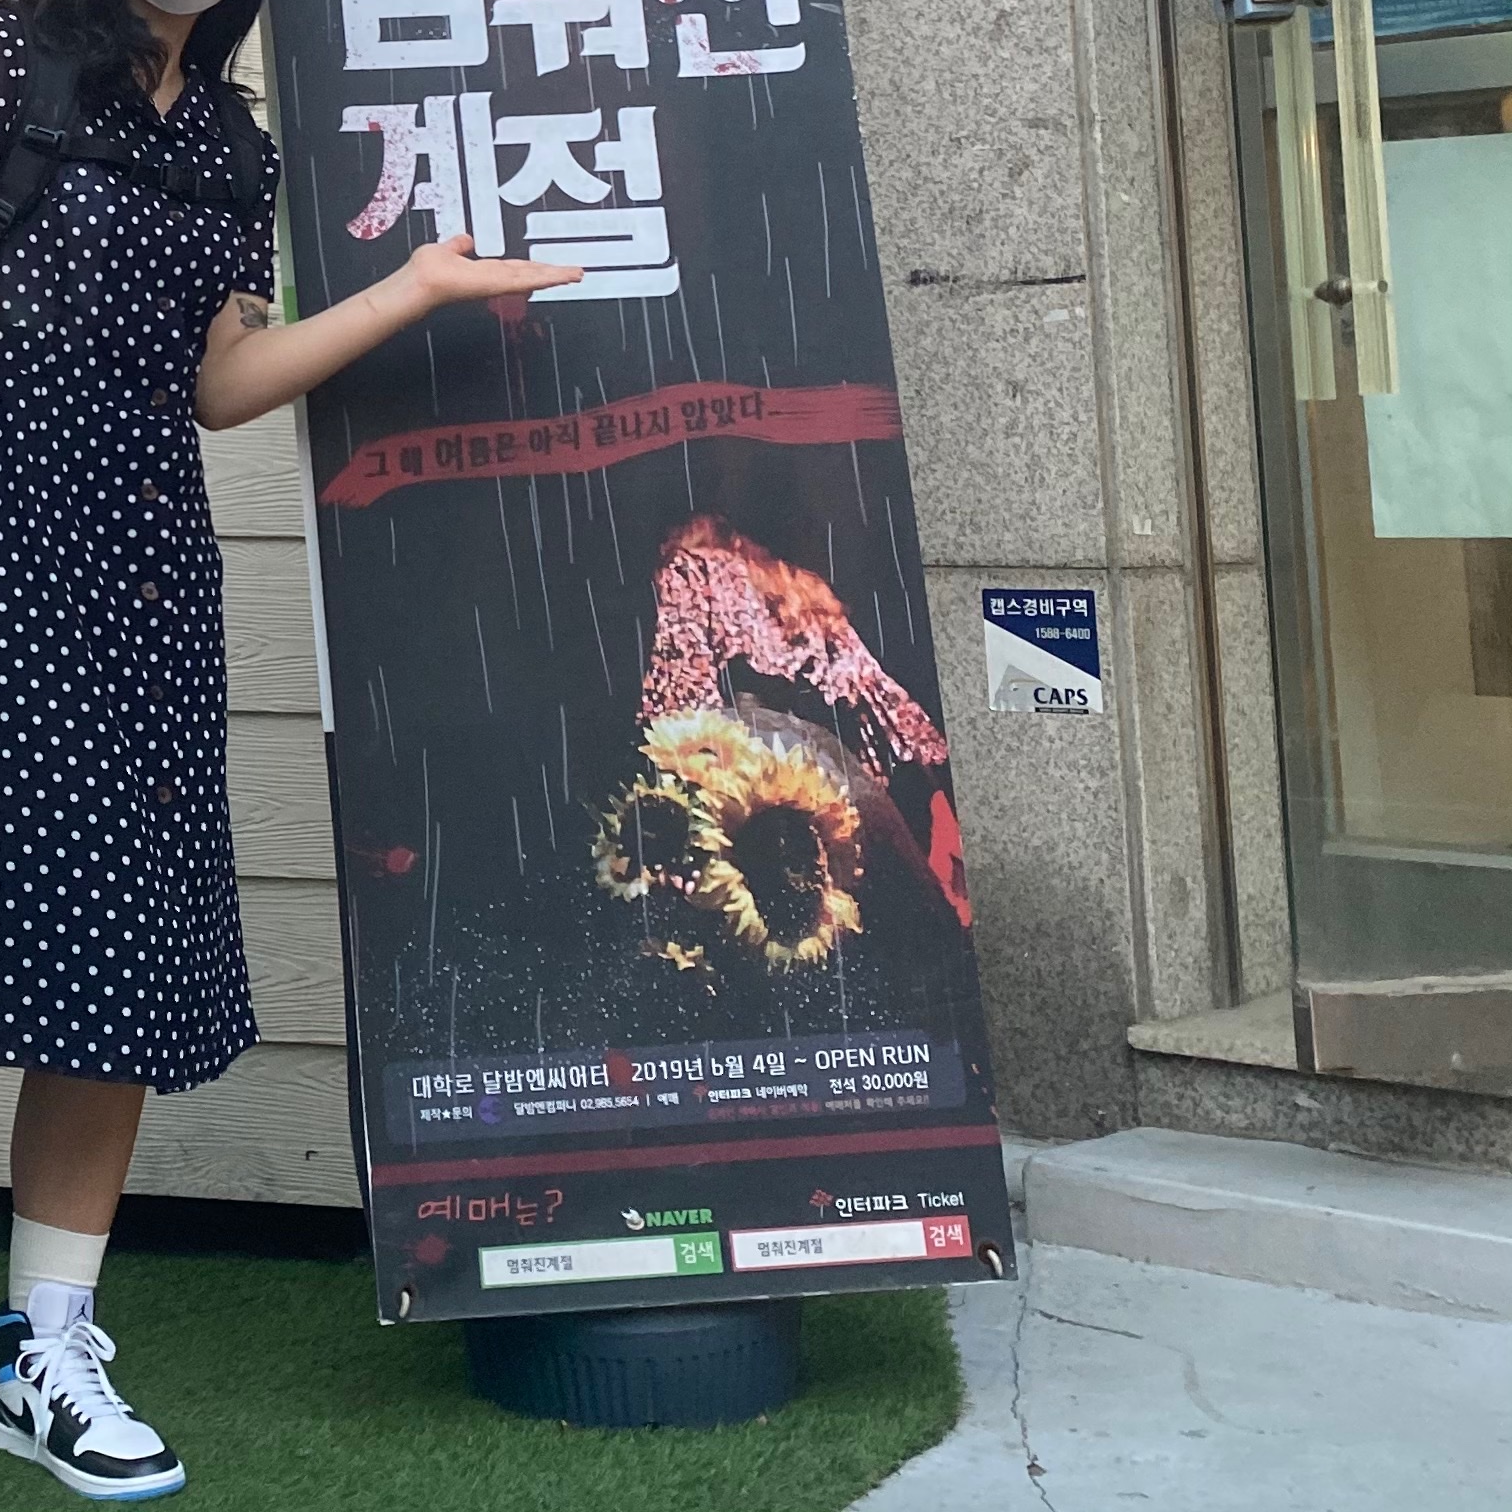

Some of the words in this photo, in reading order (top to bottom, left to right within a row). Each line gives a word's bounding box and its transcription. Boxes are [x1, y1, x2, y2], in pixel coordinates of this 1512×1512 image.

[338, 91, 680, 302] 계절
[529, 420, 582, 456] 아직
[591, 405, 671, 449] 끝나지
[679, 390, 766, 432] 않았다
[989, 597, 1088, 618] 캡스경비구역
[1035, 627, 1091, 640] 1588-6400
[1033, 687, 1088, 706] CAPS
[412, 1072, 475, 1099] 대학로
[482, 1062, 611, 1096] 달밤엔씨어터
[630, 1057, 705, 1084] 2019년
[752, 1051, 787, 1076] 4일
[814, 1046, 875, 1070] OPEN
[882, 1043, 931, 1066] RUN
[828, 1077, 857, 1096] 전석
[417, 1188, 565, 1228] 예매는?
[645, 1206, 715, 1228] NAVER
[835, 1193, 910, 1217] 인터파크
[916, 1190, 966, 1209] Ticket
[756, 1236, 824, 1258] 멈춰진계절
[929, 1223, 966, 1248] 검색
[506, 1254, 574, 1275] 멈춰진계절
[679, 1240, 716, 1264] 검색
